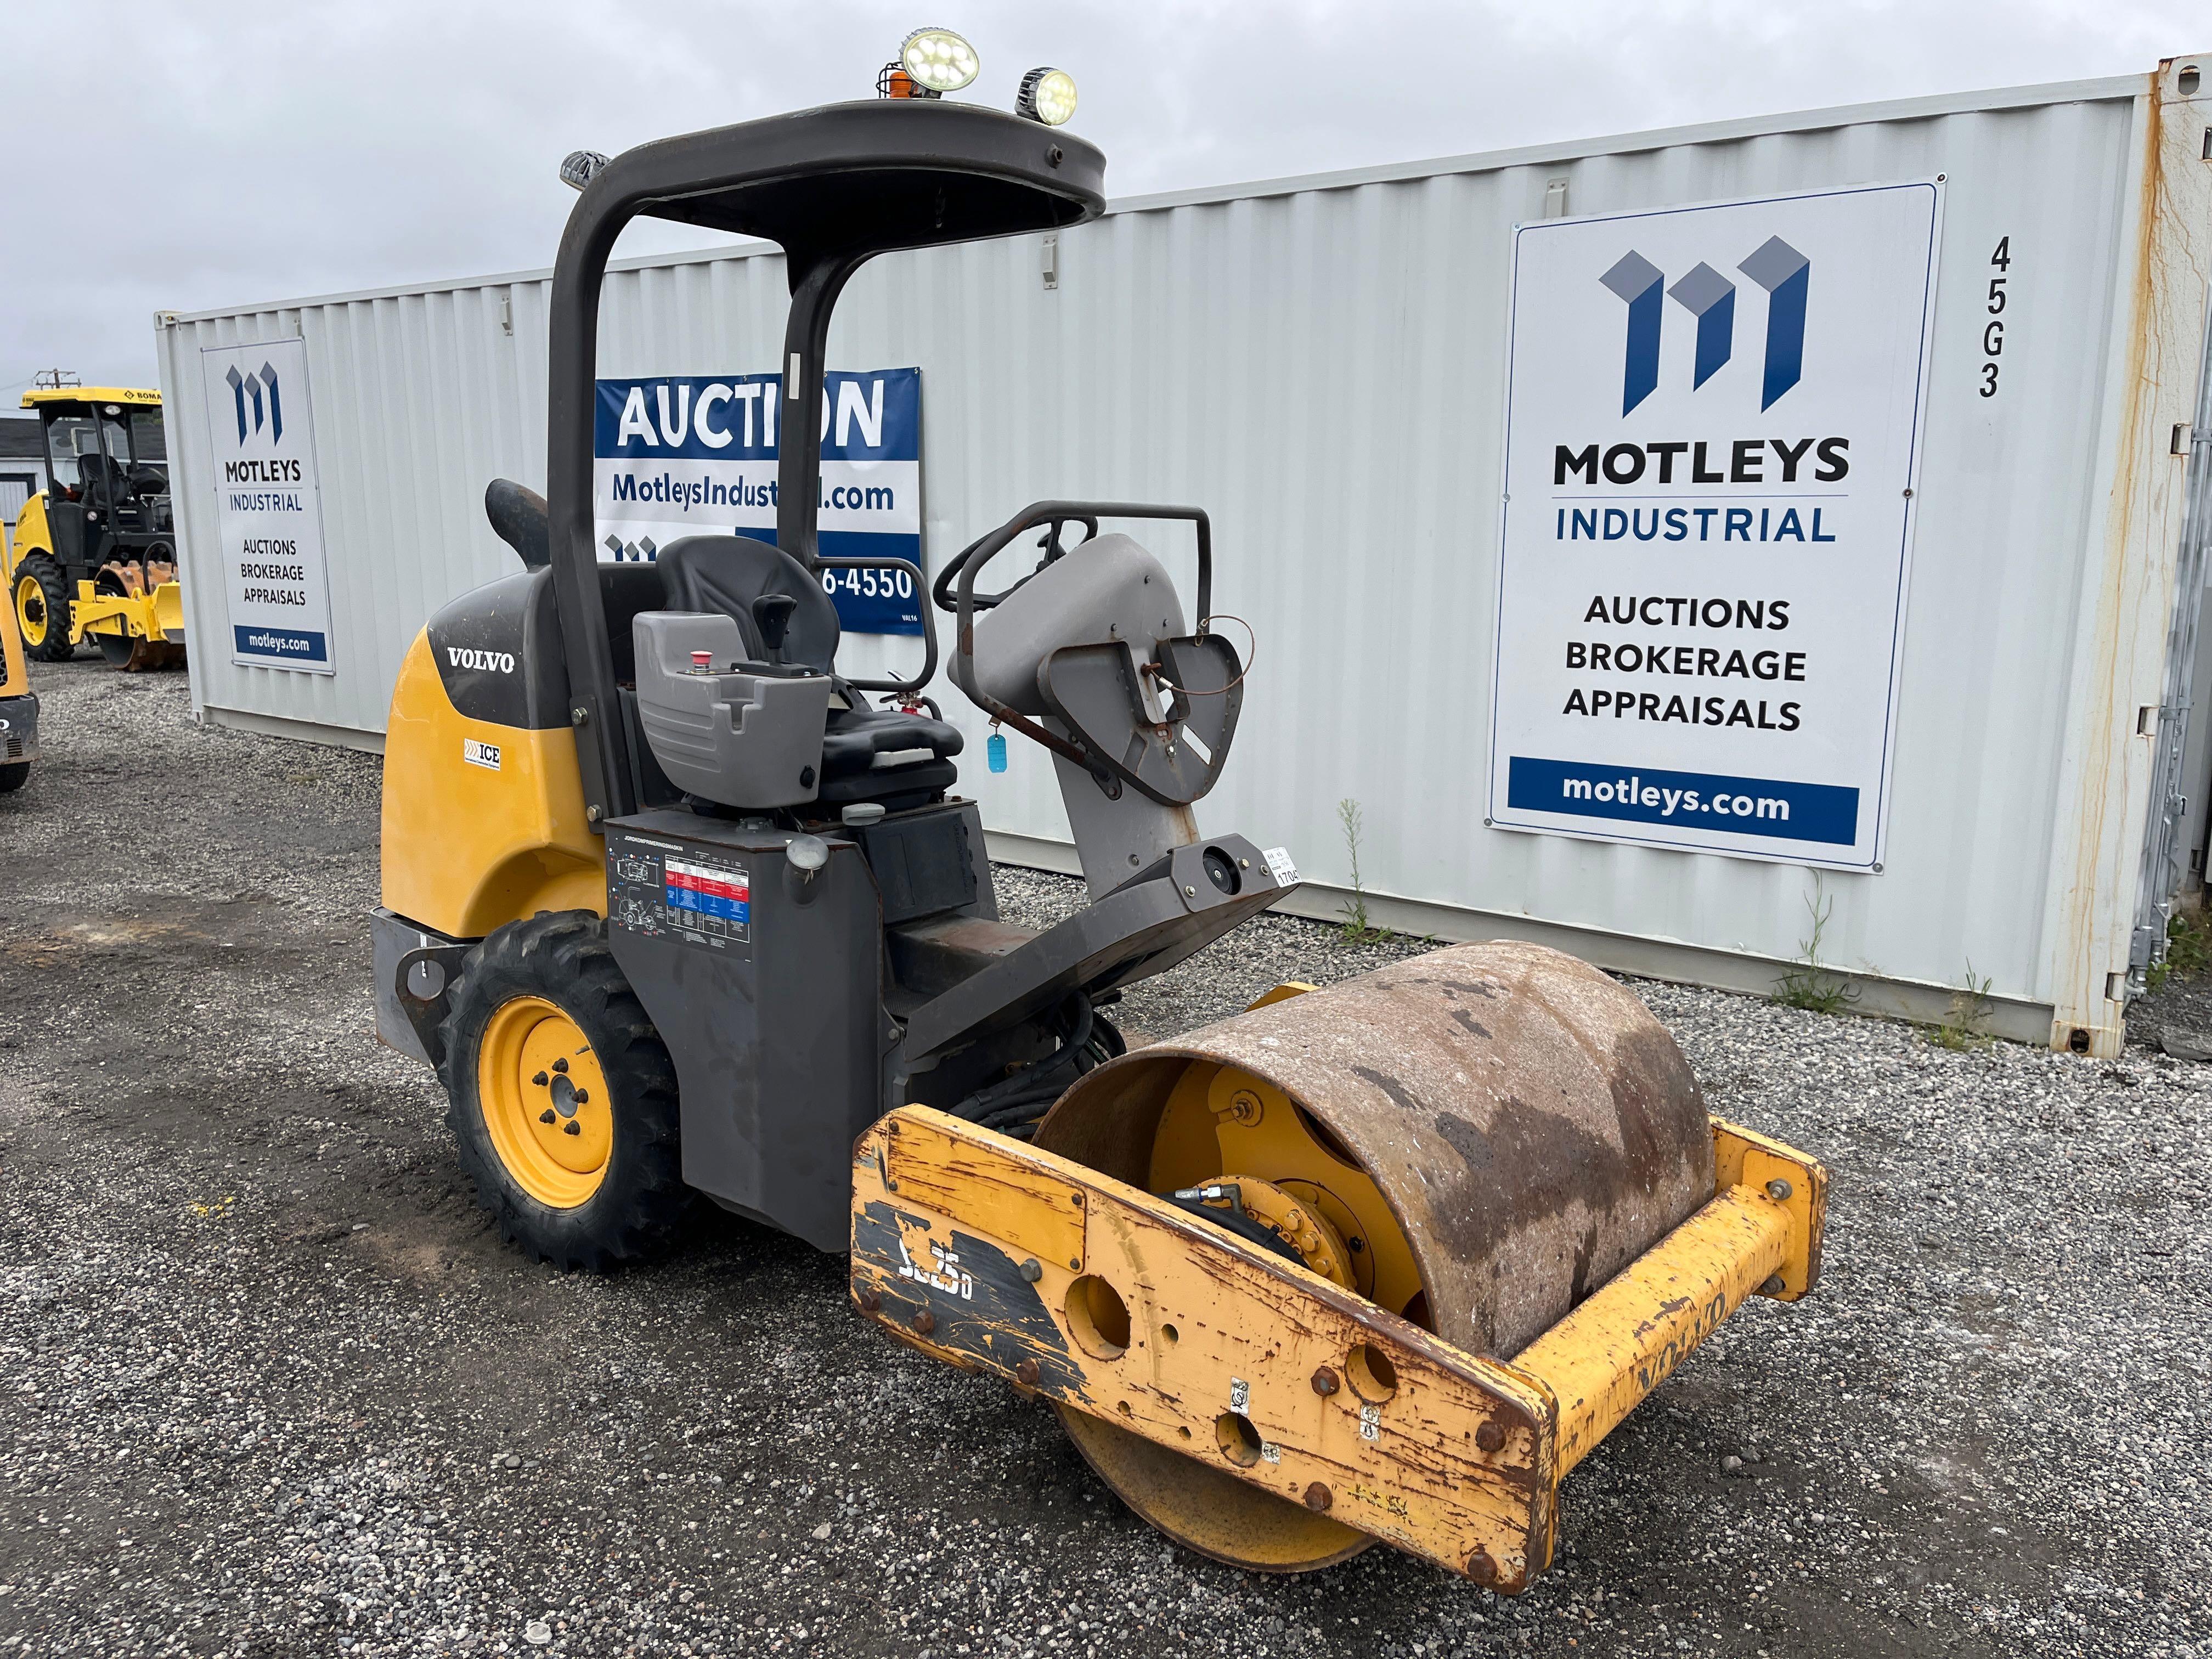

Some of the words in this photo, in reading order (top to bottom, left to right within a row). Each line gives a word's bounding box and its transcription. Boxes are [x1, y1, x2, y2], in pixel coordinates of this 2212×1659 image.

[617, 379, 884, 448] AUCTIN
[225, 460, 301, 482] MOTLEYS
[1553, 437, 1850, 486] MOTLEYS
[230, 494, 302, 511] INDUSTRIAL
[613, 472, 894, 512] MotleysIndustl.com
[1556, 507, 1836, 543] INDUSTRIAL
[243, 539, 296, 555] AUCTIONS
[241, 563, 304, 580] BROKERAGE
[244, 588, 306, 606] APPRAISALS
[1584, 595, 1791, 630] AUCTIONS
[249, 632, 310, 653] motleys.com
[447, 647, 515, 674] VOLVO
[1566, 641, 1807, 682] BROKERAGE
[1562, 689, 1802, 732] APPRAISALS
[480, 744, 499, 763] ICE
[1562, 776, 1791, 821] motleys.com
